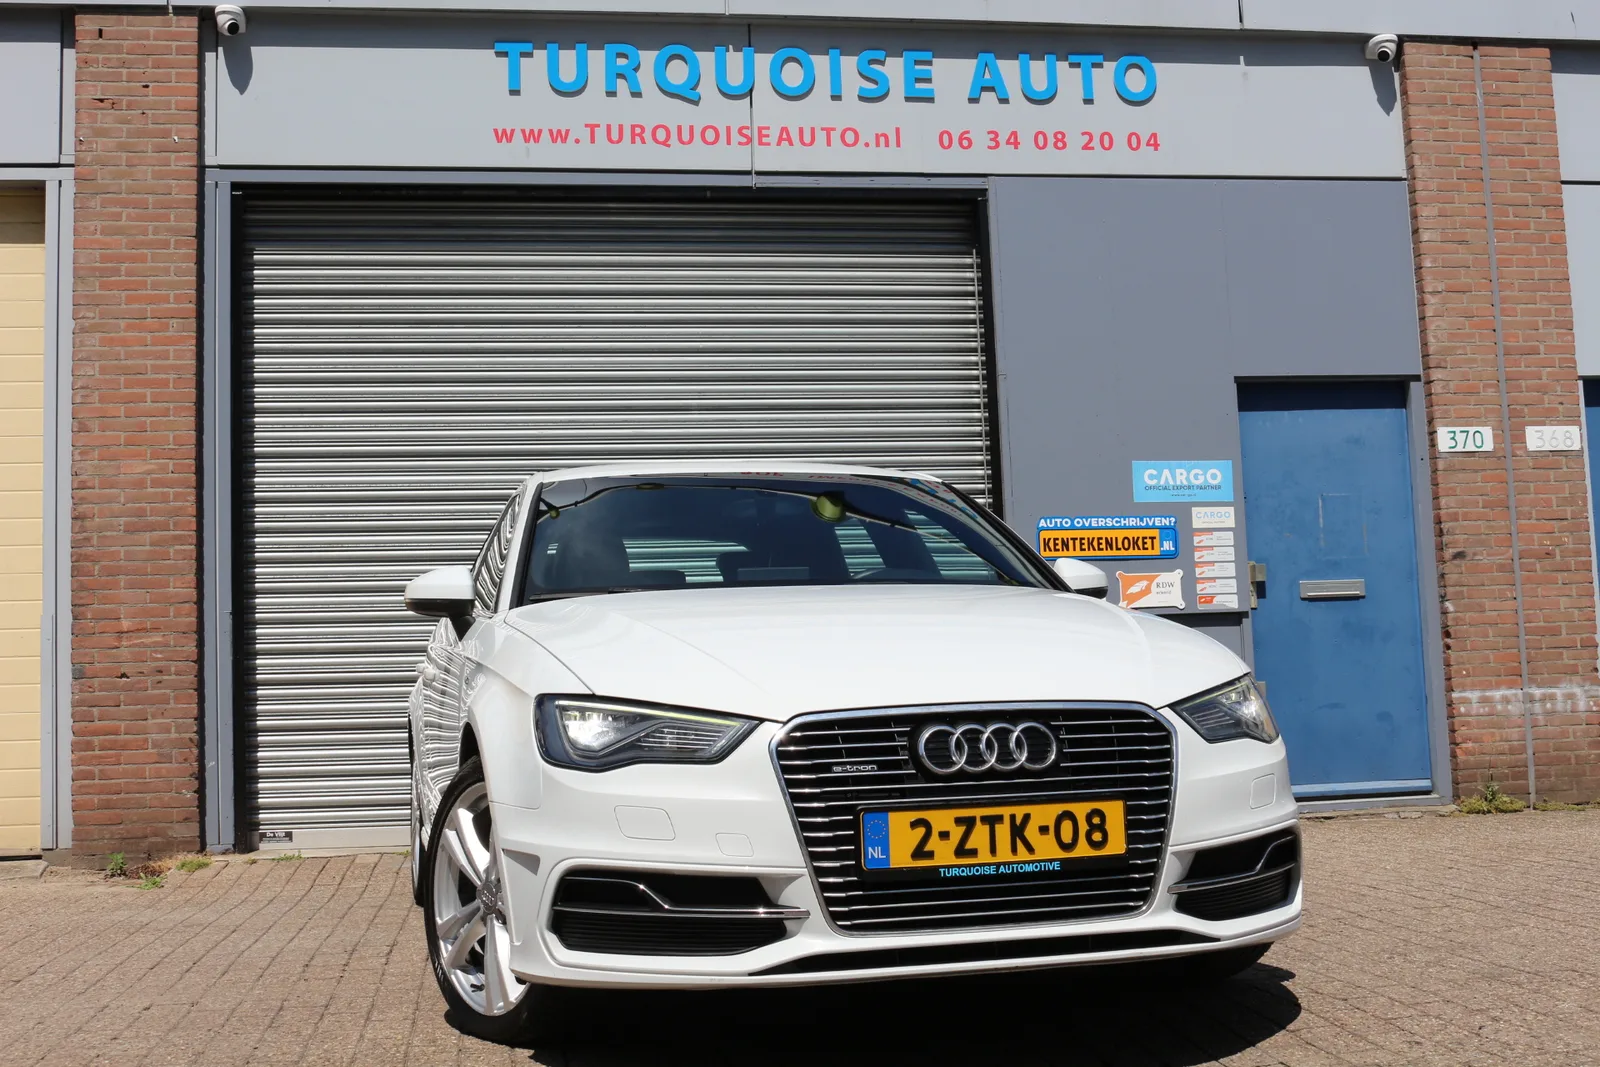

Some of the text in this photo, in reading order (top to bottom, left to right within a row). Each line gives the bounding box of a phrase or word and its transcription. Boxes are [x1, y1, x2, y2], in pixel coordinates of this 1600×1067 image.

[494, 42, 1157, 104] TURQUOISE AUTO
[493, 123, 1161, 152] www.TURQUOISEAUTO.nl 06 34 08 20 04
[1447, 430, 1484, 449] 370
[1535, 430, 1575, 449] 368
[1143, 468, 1222, 485] CARGO
[1038, 517, 1176, 528] AUTO OVERSCHRIJVEN?
[1195, 511, 1231, 519] CARGO
[1042, 536, 1157, 552] KENTEKENLOKET
[1156, 581, 1175, 589] RDW
[833, 764, 877, 773] e-tron
[909, 808, 1109, 861] 2-ZTK-08
[868, 847, 886, 859] NL
[939, 861, 1061, 877] TURQUOISE AUTOMOTIVE
